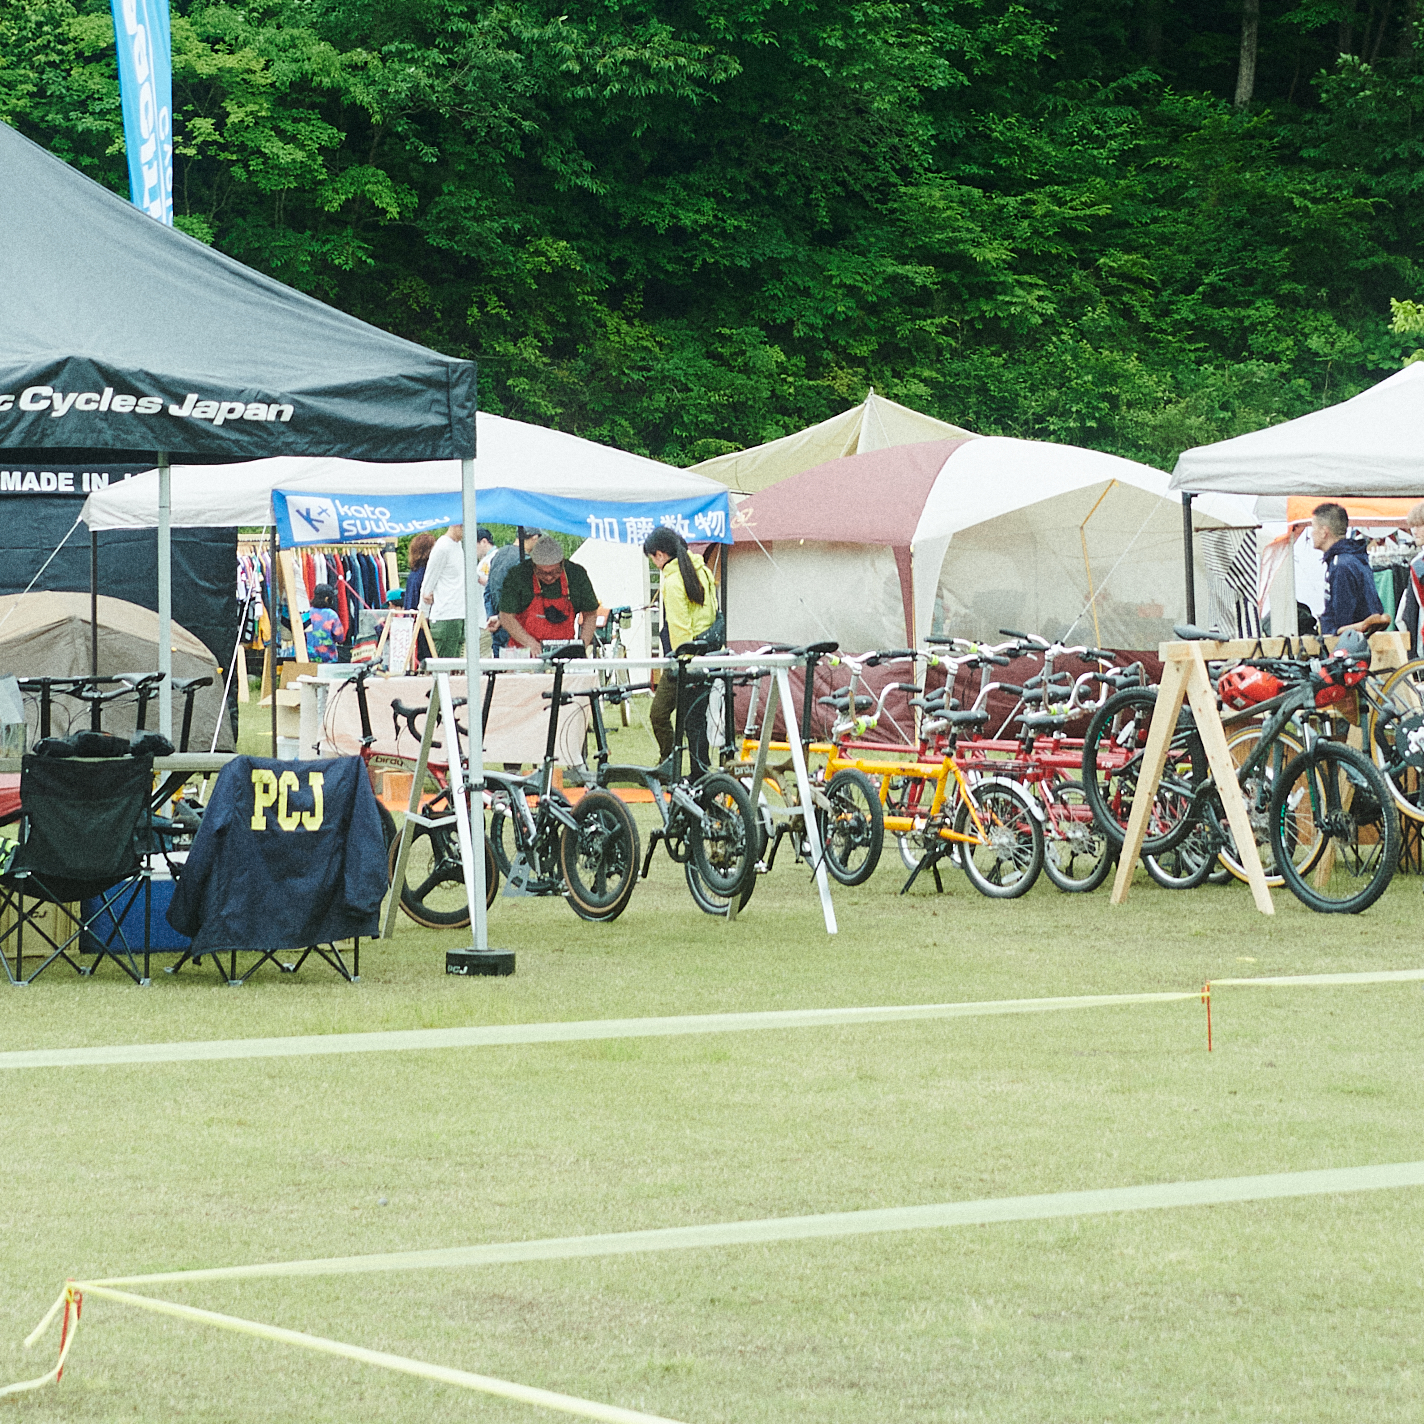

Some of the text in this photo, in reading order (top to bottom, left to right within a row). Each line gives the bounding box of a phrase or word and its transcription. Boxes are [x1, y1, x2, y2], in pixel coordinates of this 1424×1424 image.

[18, 386, 164, 418] Cycles
[168, 393, 295, 425] Japan
[0, 472, 75, 492] MADE
[82, 473, 109, 492] IN
[335, 499, 391, 519] kato
[375, 755, 404, 767] birdy
[251, 769, 325, 831] PCJ
